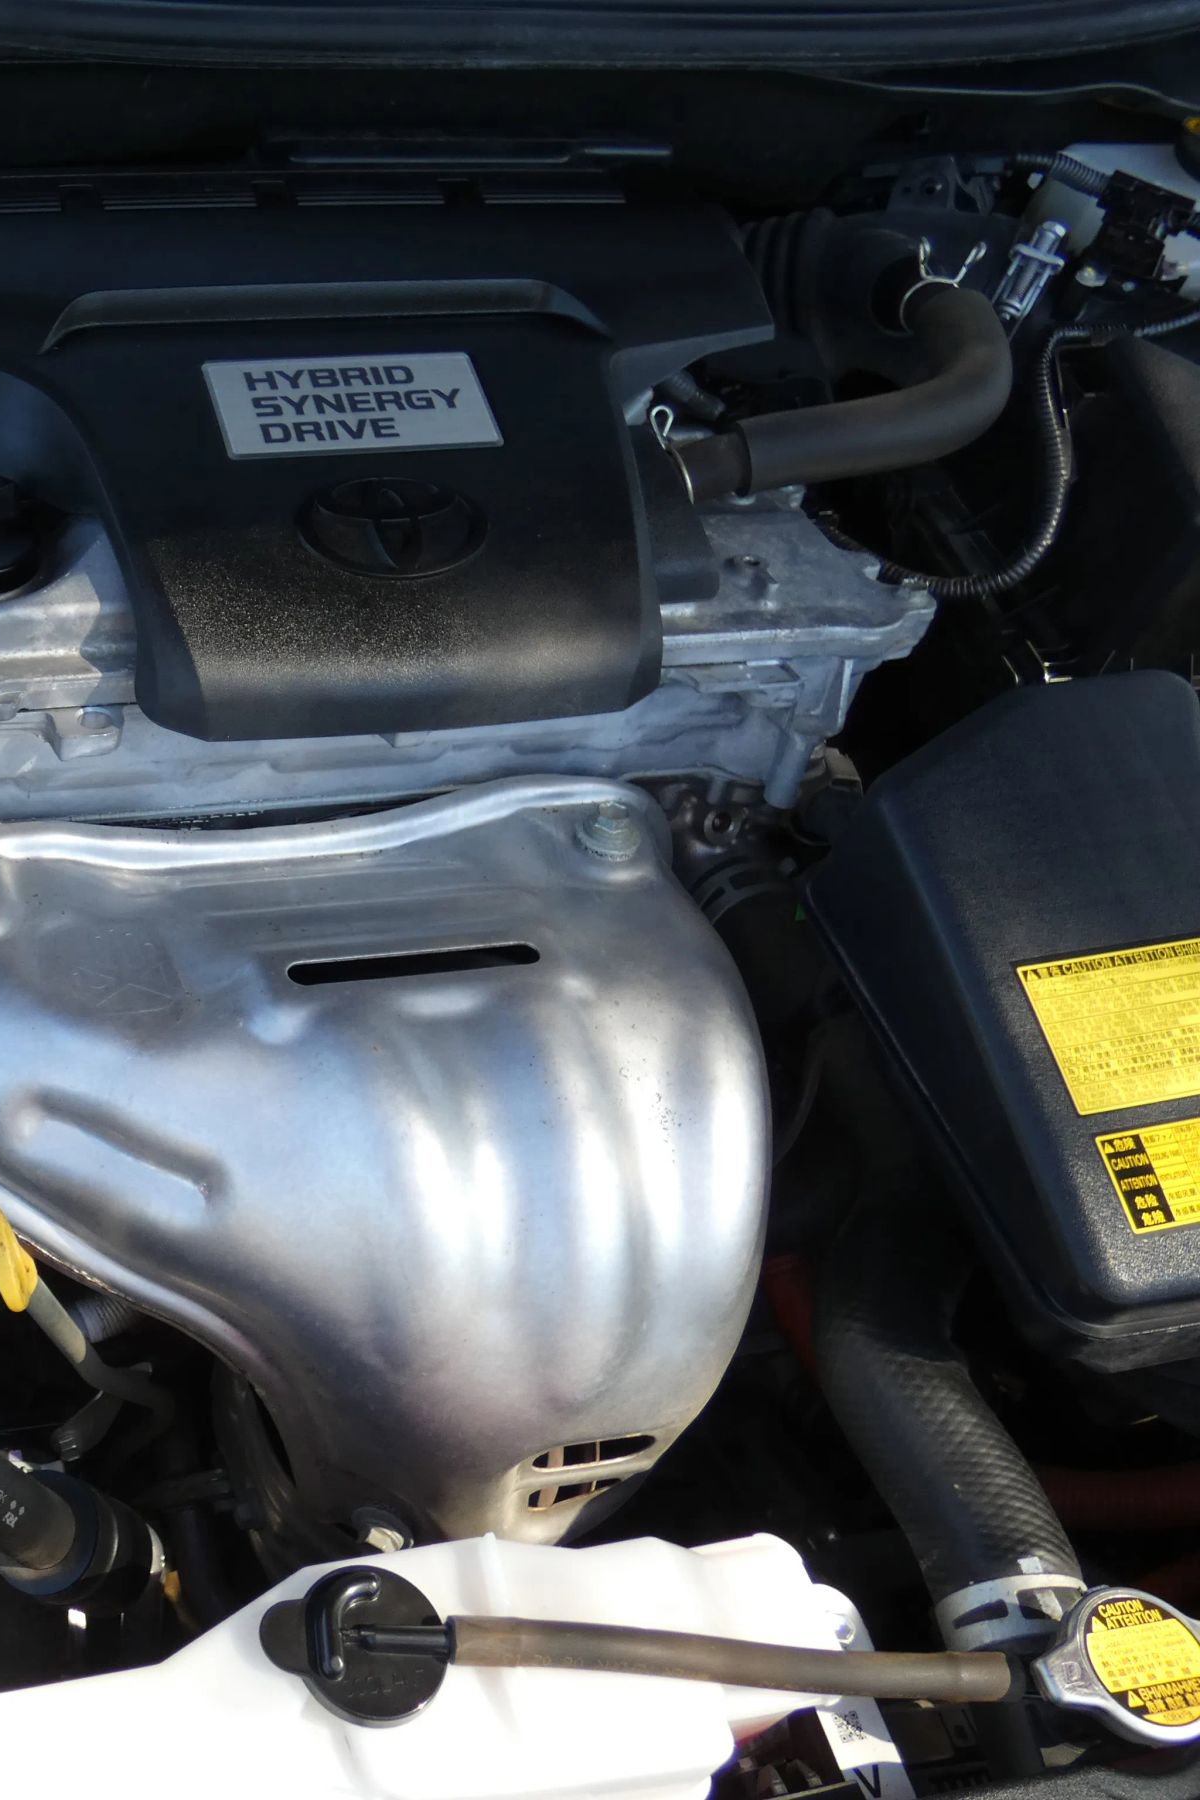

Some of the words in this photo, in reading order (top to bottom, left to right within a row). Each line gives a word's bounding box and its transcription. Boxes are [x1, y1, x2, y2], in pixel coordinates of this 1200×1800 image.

[243, 364, 414, 392] HYBRID
[251, 388, 460, 418] SYNERGY
[259, 417, 401, 444] DRIVE
[1062, 958, 1111, 974] CAUTION
[1114, 947, 1174, 967] ATTENTION
[1111, 1153, 1149, 1171] CAUTION
[1120, 1174, 1158, 1192] ATTENTION
[1098, 1599, 1144, 1618] CAUTION
[1106, 1609, 1163, 1629] ATTENTION
[1139, 1677, 1200, 1701] ВНИМАНИЕ
[852, 1764, 881, 1798] V
